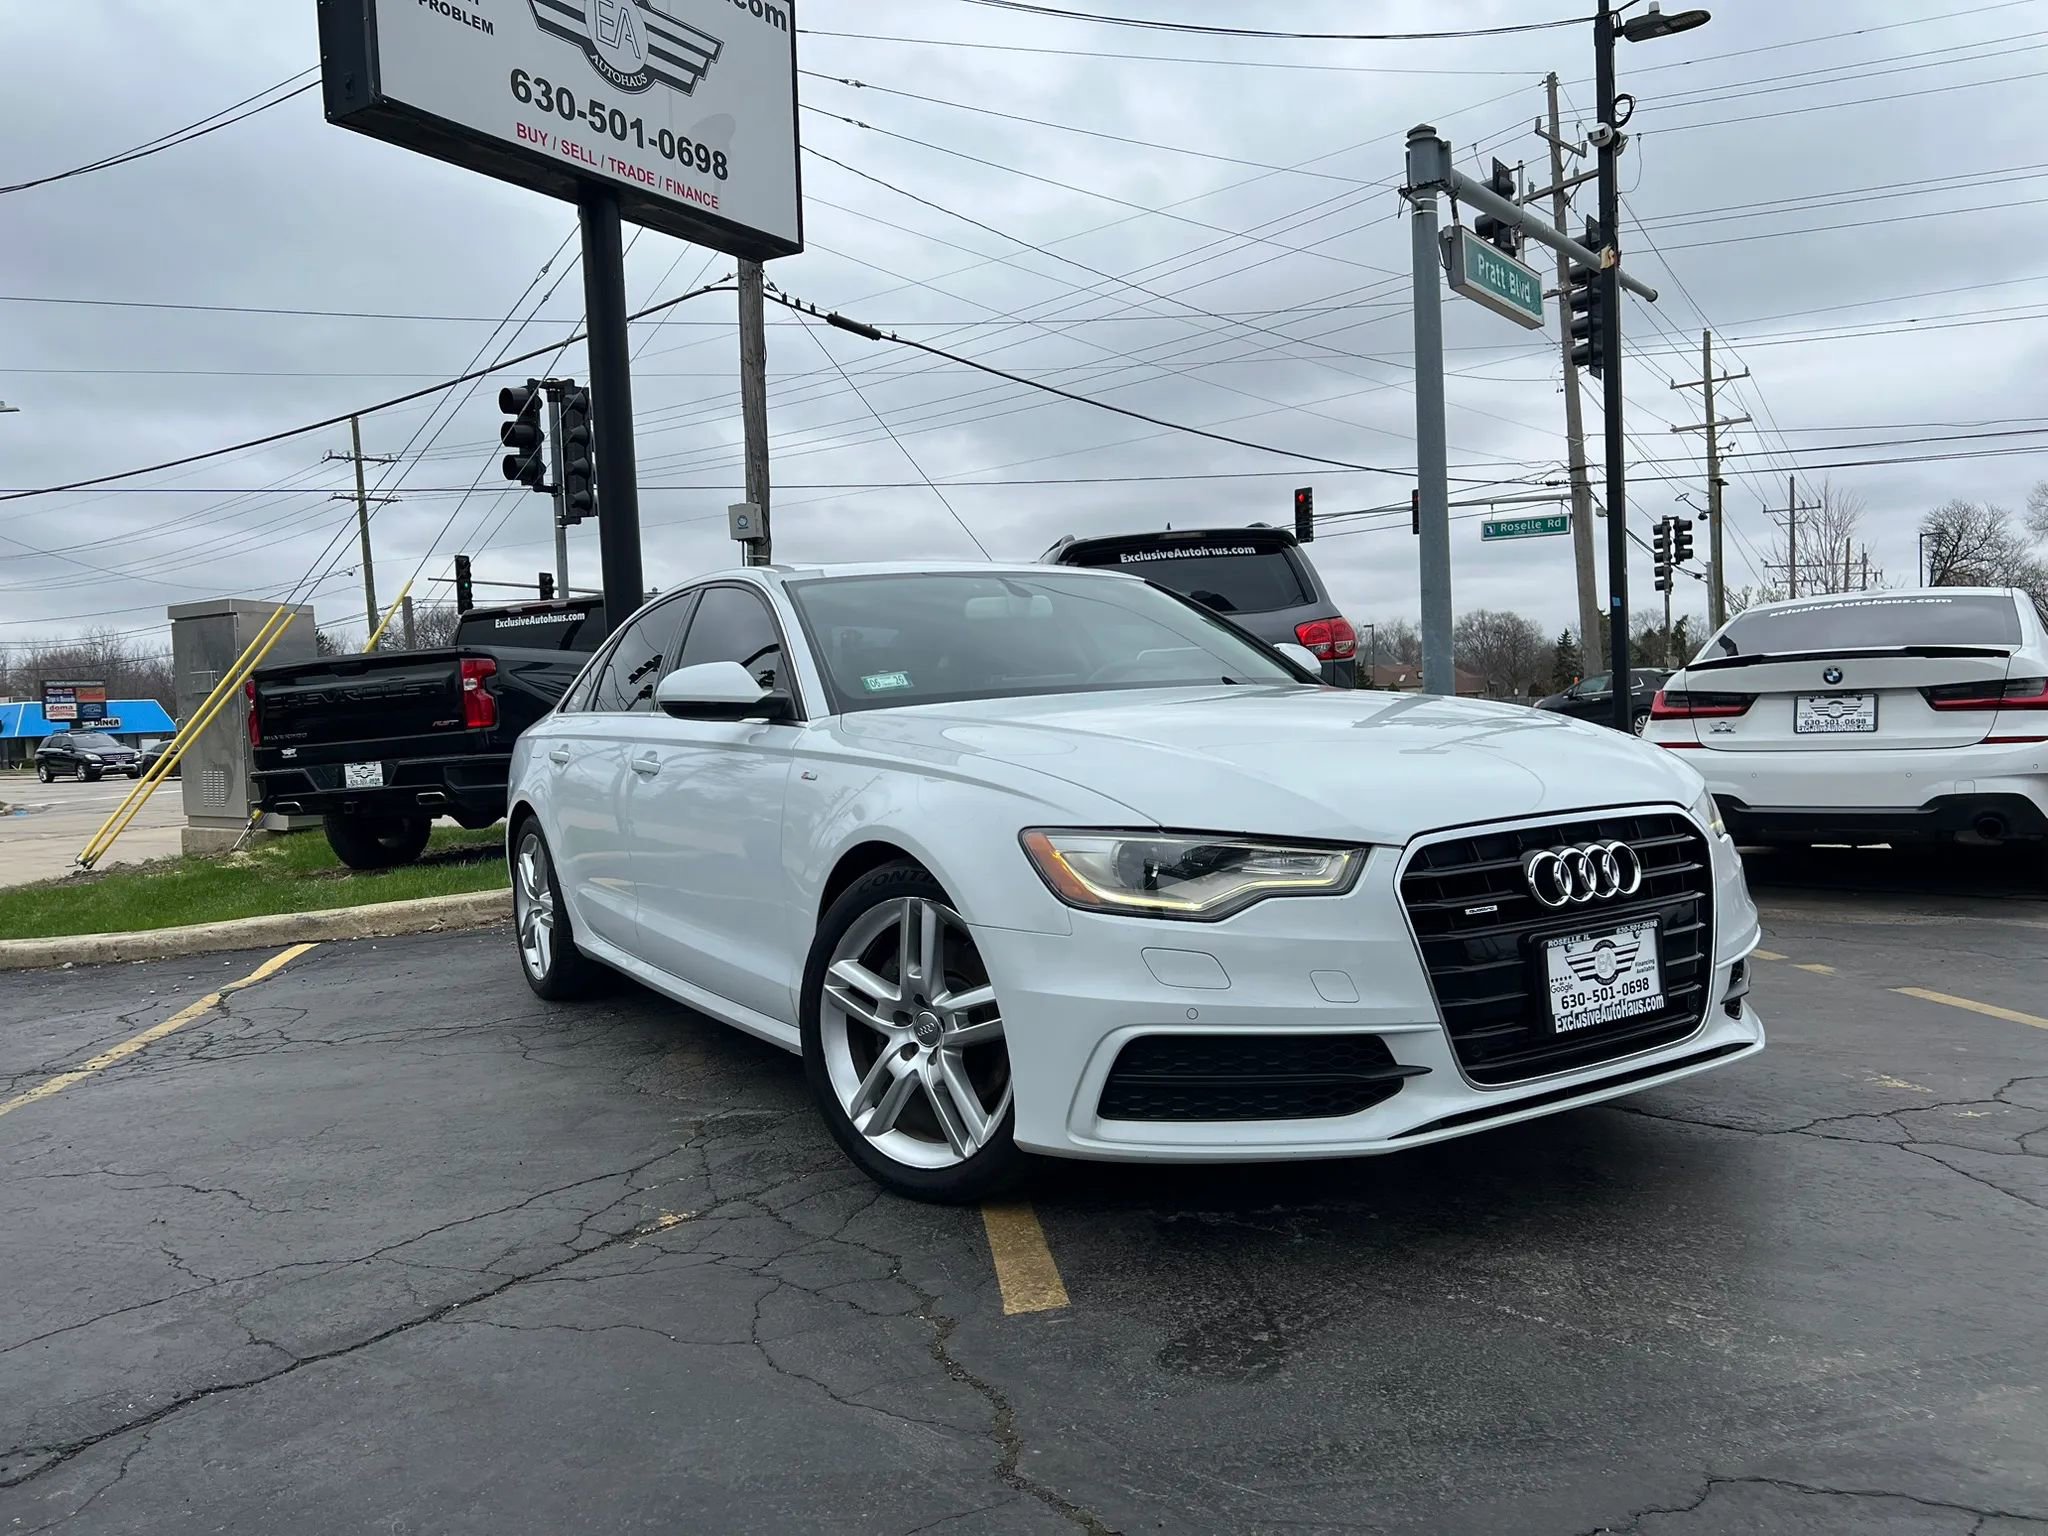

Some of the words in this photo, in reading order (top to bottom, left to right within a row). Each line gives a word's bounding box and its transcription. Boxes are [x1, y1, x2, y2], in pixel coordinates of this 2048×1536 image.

[589, 54, 648, 87] AUTOHAUS
[510, 68, 728, 180] 630-501-0698
[516, 122, 548, 147] BUY
[561, 139, 598, 166] SELL
[608, 157, 656, 187] TRADE
[666, 179, 720, 210] FINANCE
[1477, 253, 1506, 290] Pratt
[1509, 271, 1531, 303] Blvd
[1500, 521, 1542, 532] Roselle
[1547, 518, 1561, 528] Rd
[1120, 545, 1256, 563] ExclusiveAutohaus.com
[495, 612, 585, 629] ExclusiveAutohaus.com
[1768, 598, 1952, 617] xclusiveAutohaus.com
[1550, 982, 1573, 994] Google
[1561, 977, 1650, 1010] 630-501-0698
[1555, 994, 1665, 1034] ExclusiveAutoHaus.com
